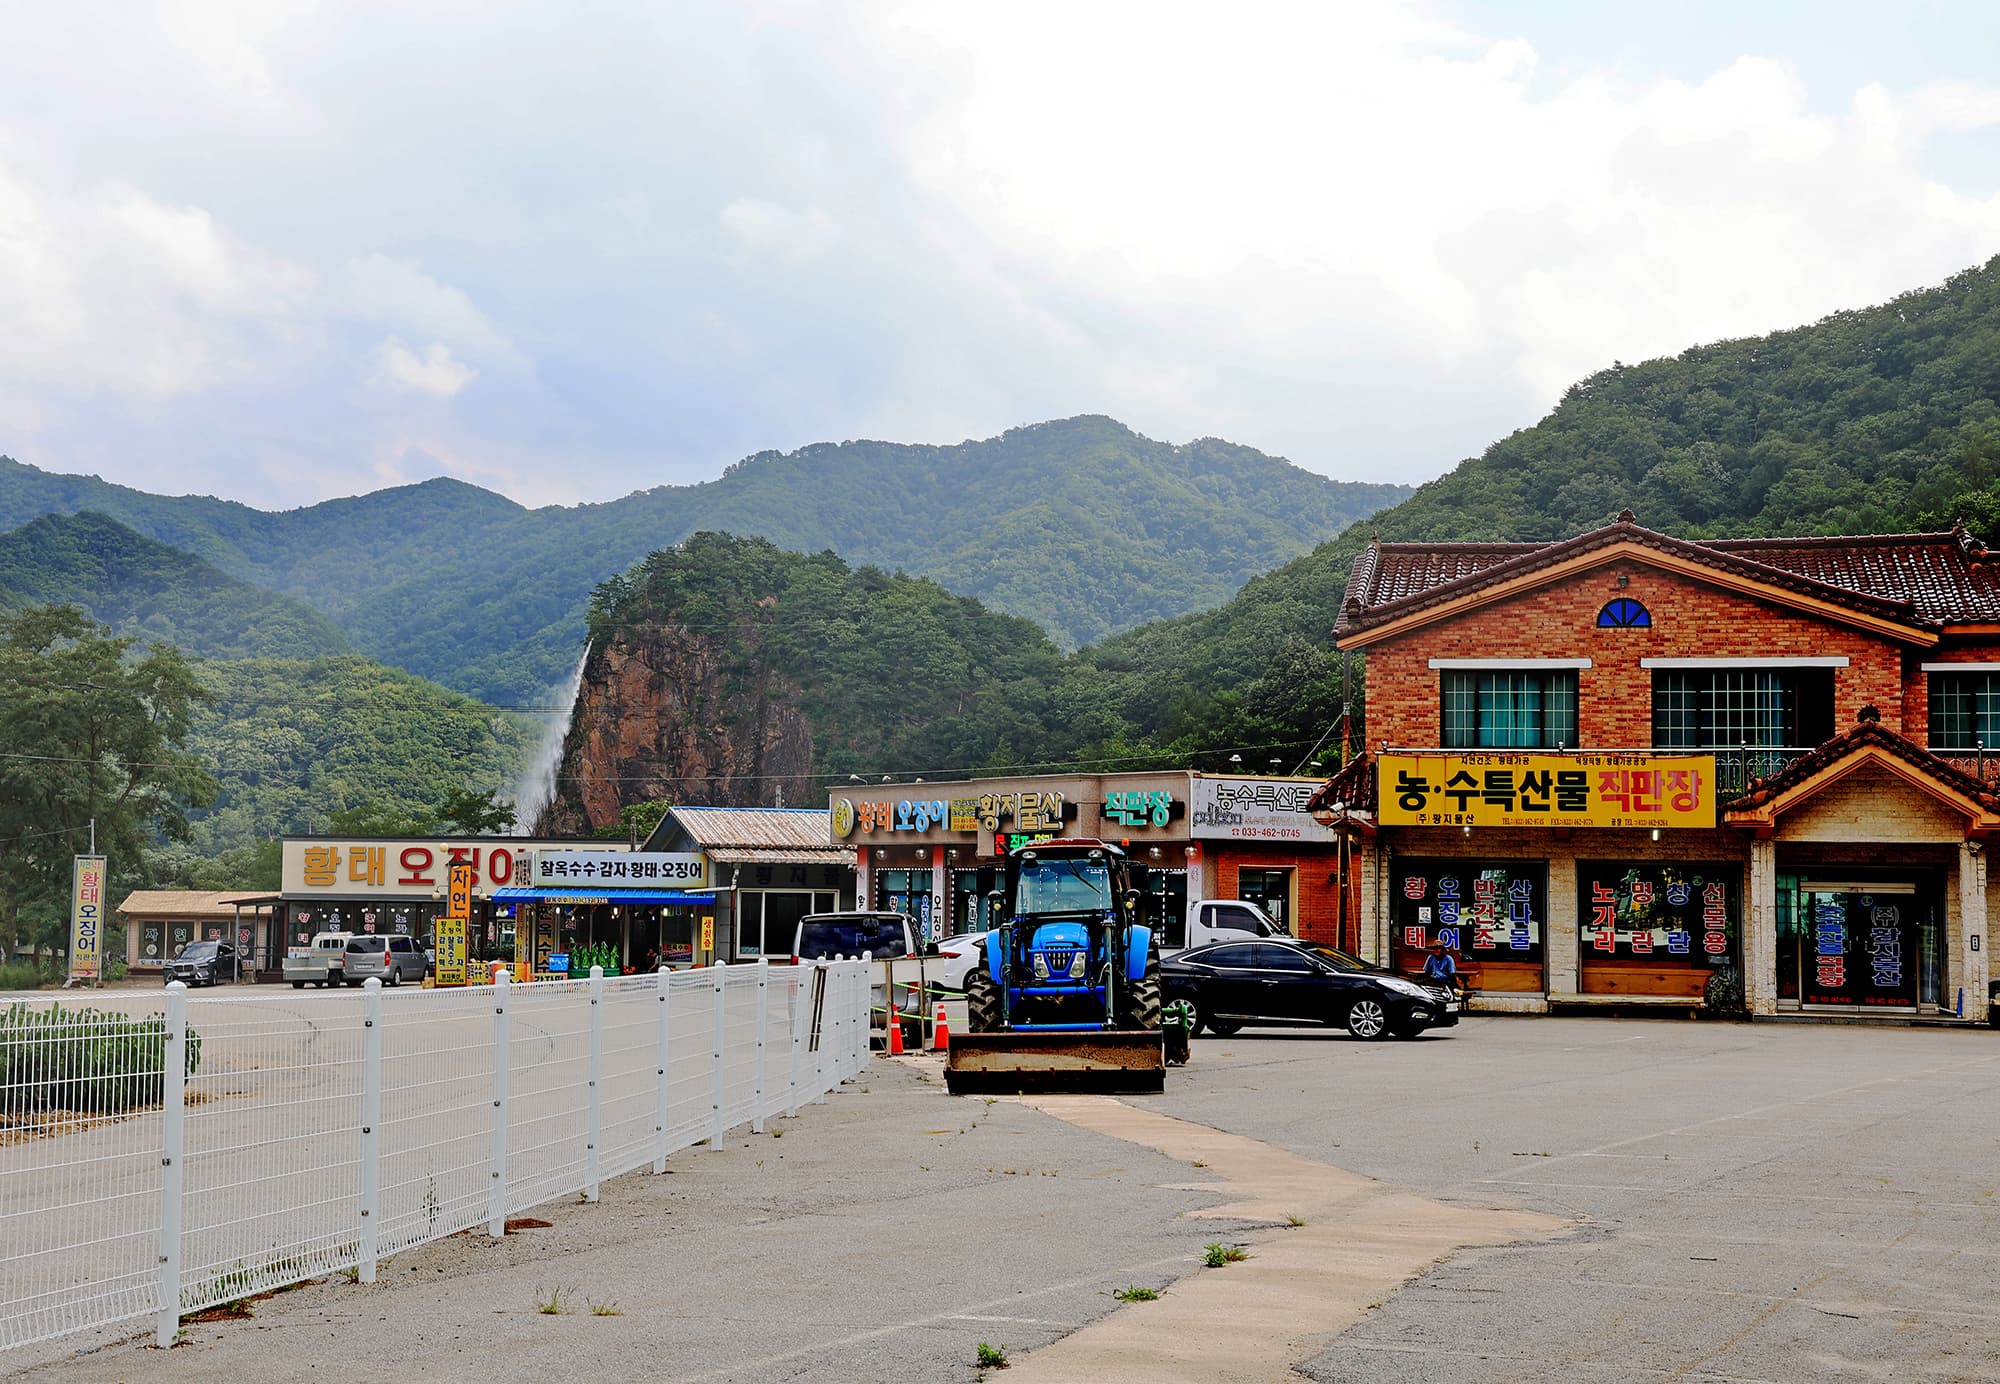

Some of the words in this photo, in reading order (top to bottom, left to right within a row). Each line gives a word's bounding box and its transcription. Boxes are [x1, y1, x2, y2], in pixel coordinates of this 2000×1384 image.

[858, 801, 894, 834] 황태
[895, 800, 949, 833] 오징어
[979, 792, 1064, 832] 황지물산
[1105, 791, 1173, 828] 직판장
[1598, 770, 1702, 812] 직판장
[1241, 827, 1301, 838] 033-462-0745
[80, 871, 100, 904] 황태
[303, 846, 386, 887] 황태
[78, 904, 98, 953] 오징어
[1403, 877, 1428, 949] 황태
[1437, 877, 1461, 951] 오징어
[1472, 879, 1497, 949] 반건조
[1508, 880, 1533, 950] 산나물
[1592, 881, 1617, 953] 노가리
[1631, 882, 1654, 953] 명란
[1667, 882, 1692, 953] 창란
[1703, 882, 1727, 954] 선물용
